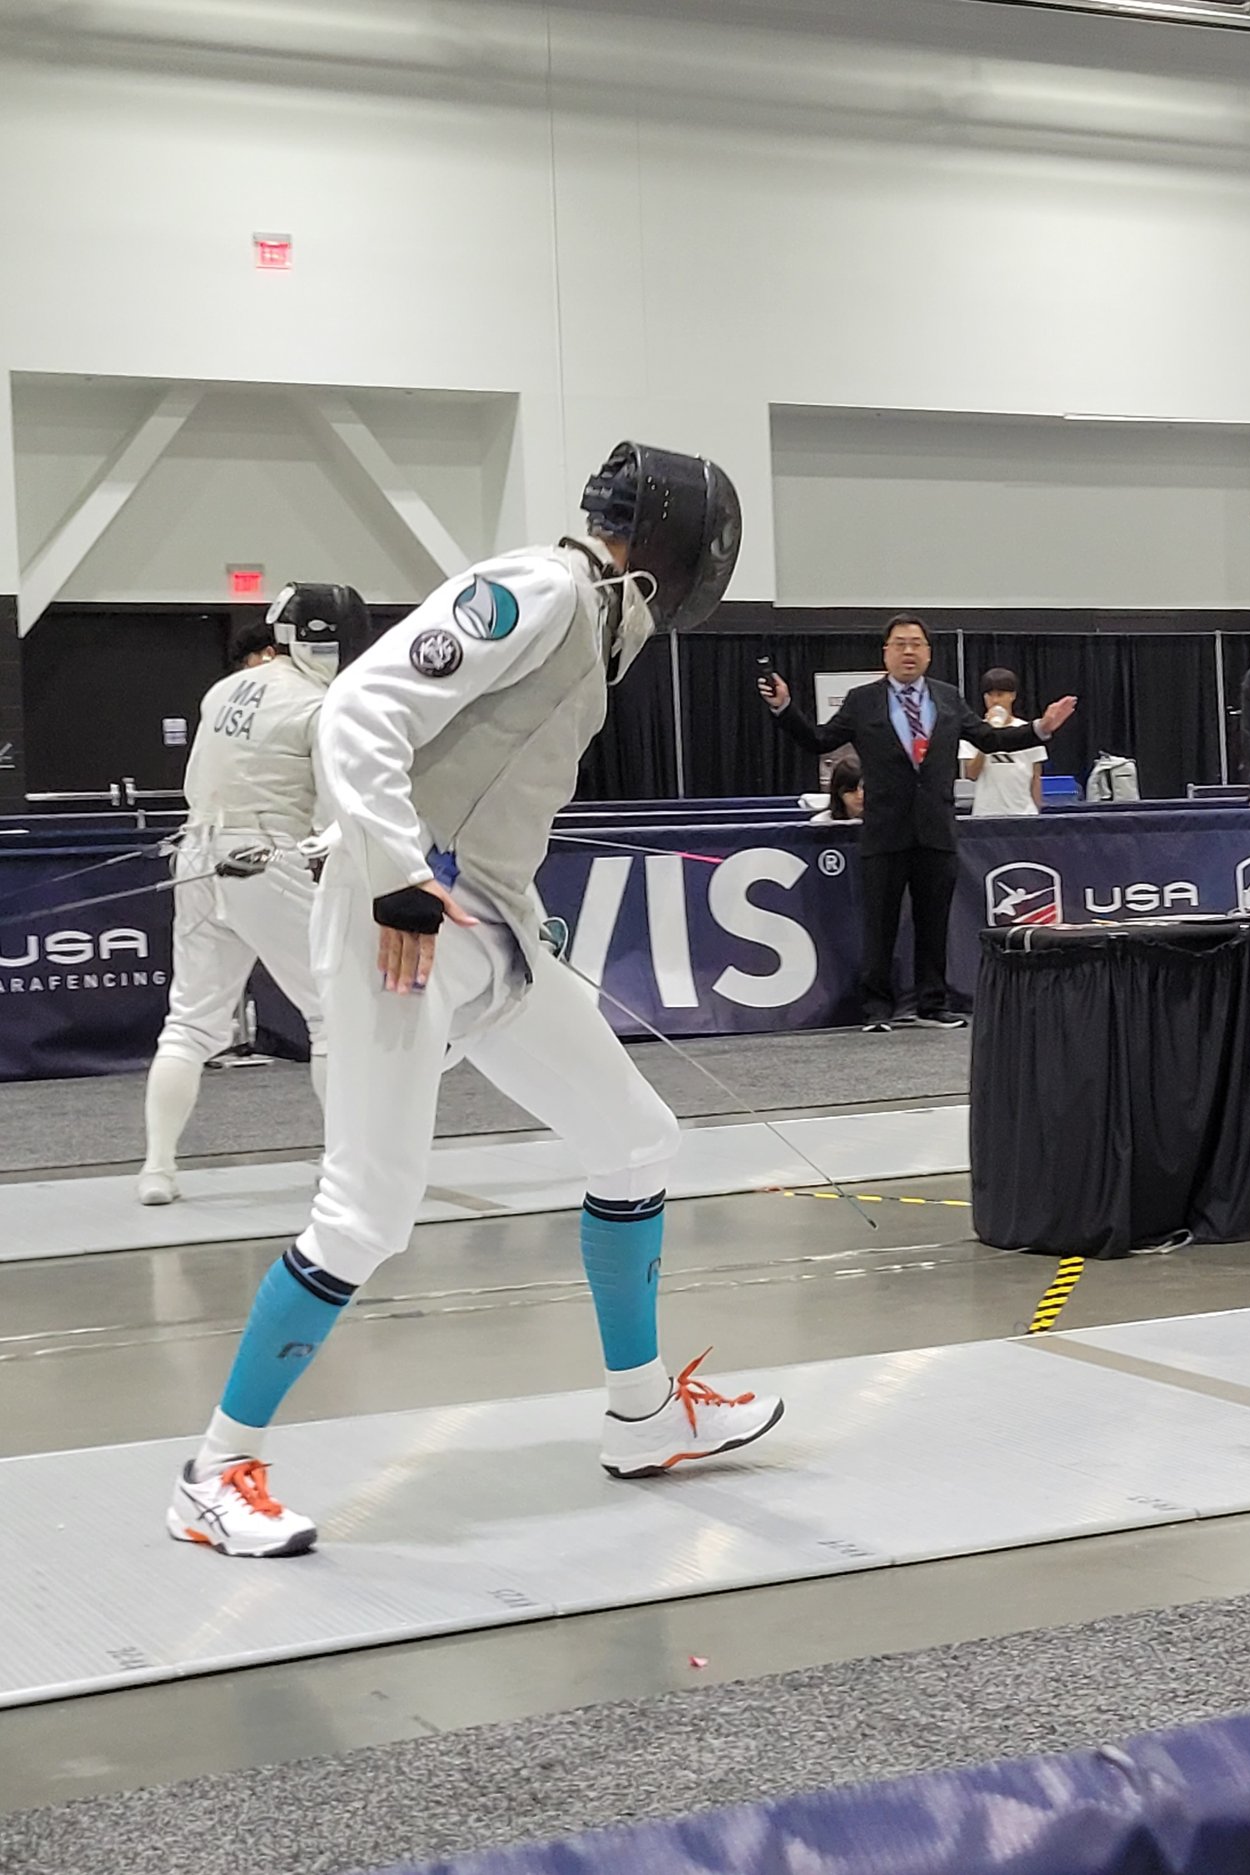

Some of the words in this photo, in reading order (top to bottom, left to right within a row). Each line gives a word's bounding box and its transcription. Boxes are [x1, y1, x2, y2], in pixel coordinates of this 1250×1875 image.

[228, 680, 268, 708] MA
[213, 705, 255, 740] USA
[1084, 881, 1199, 913] USA
